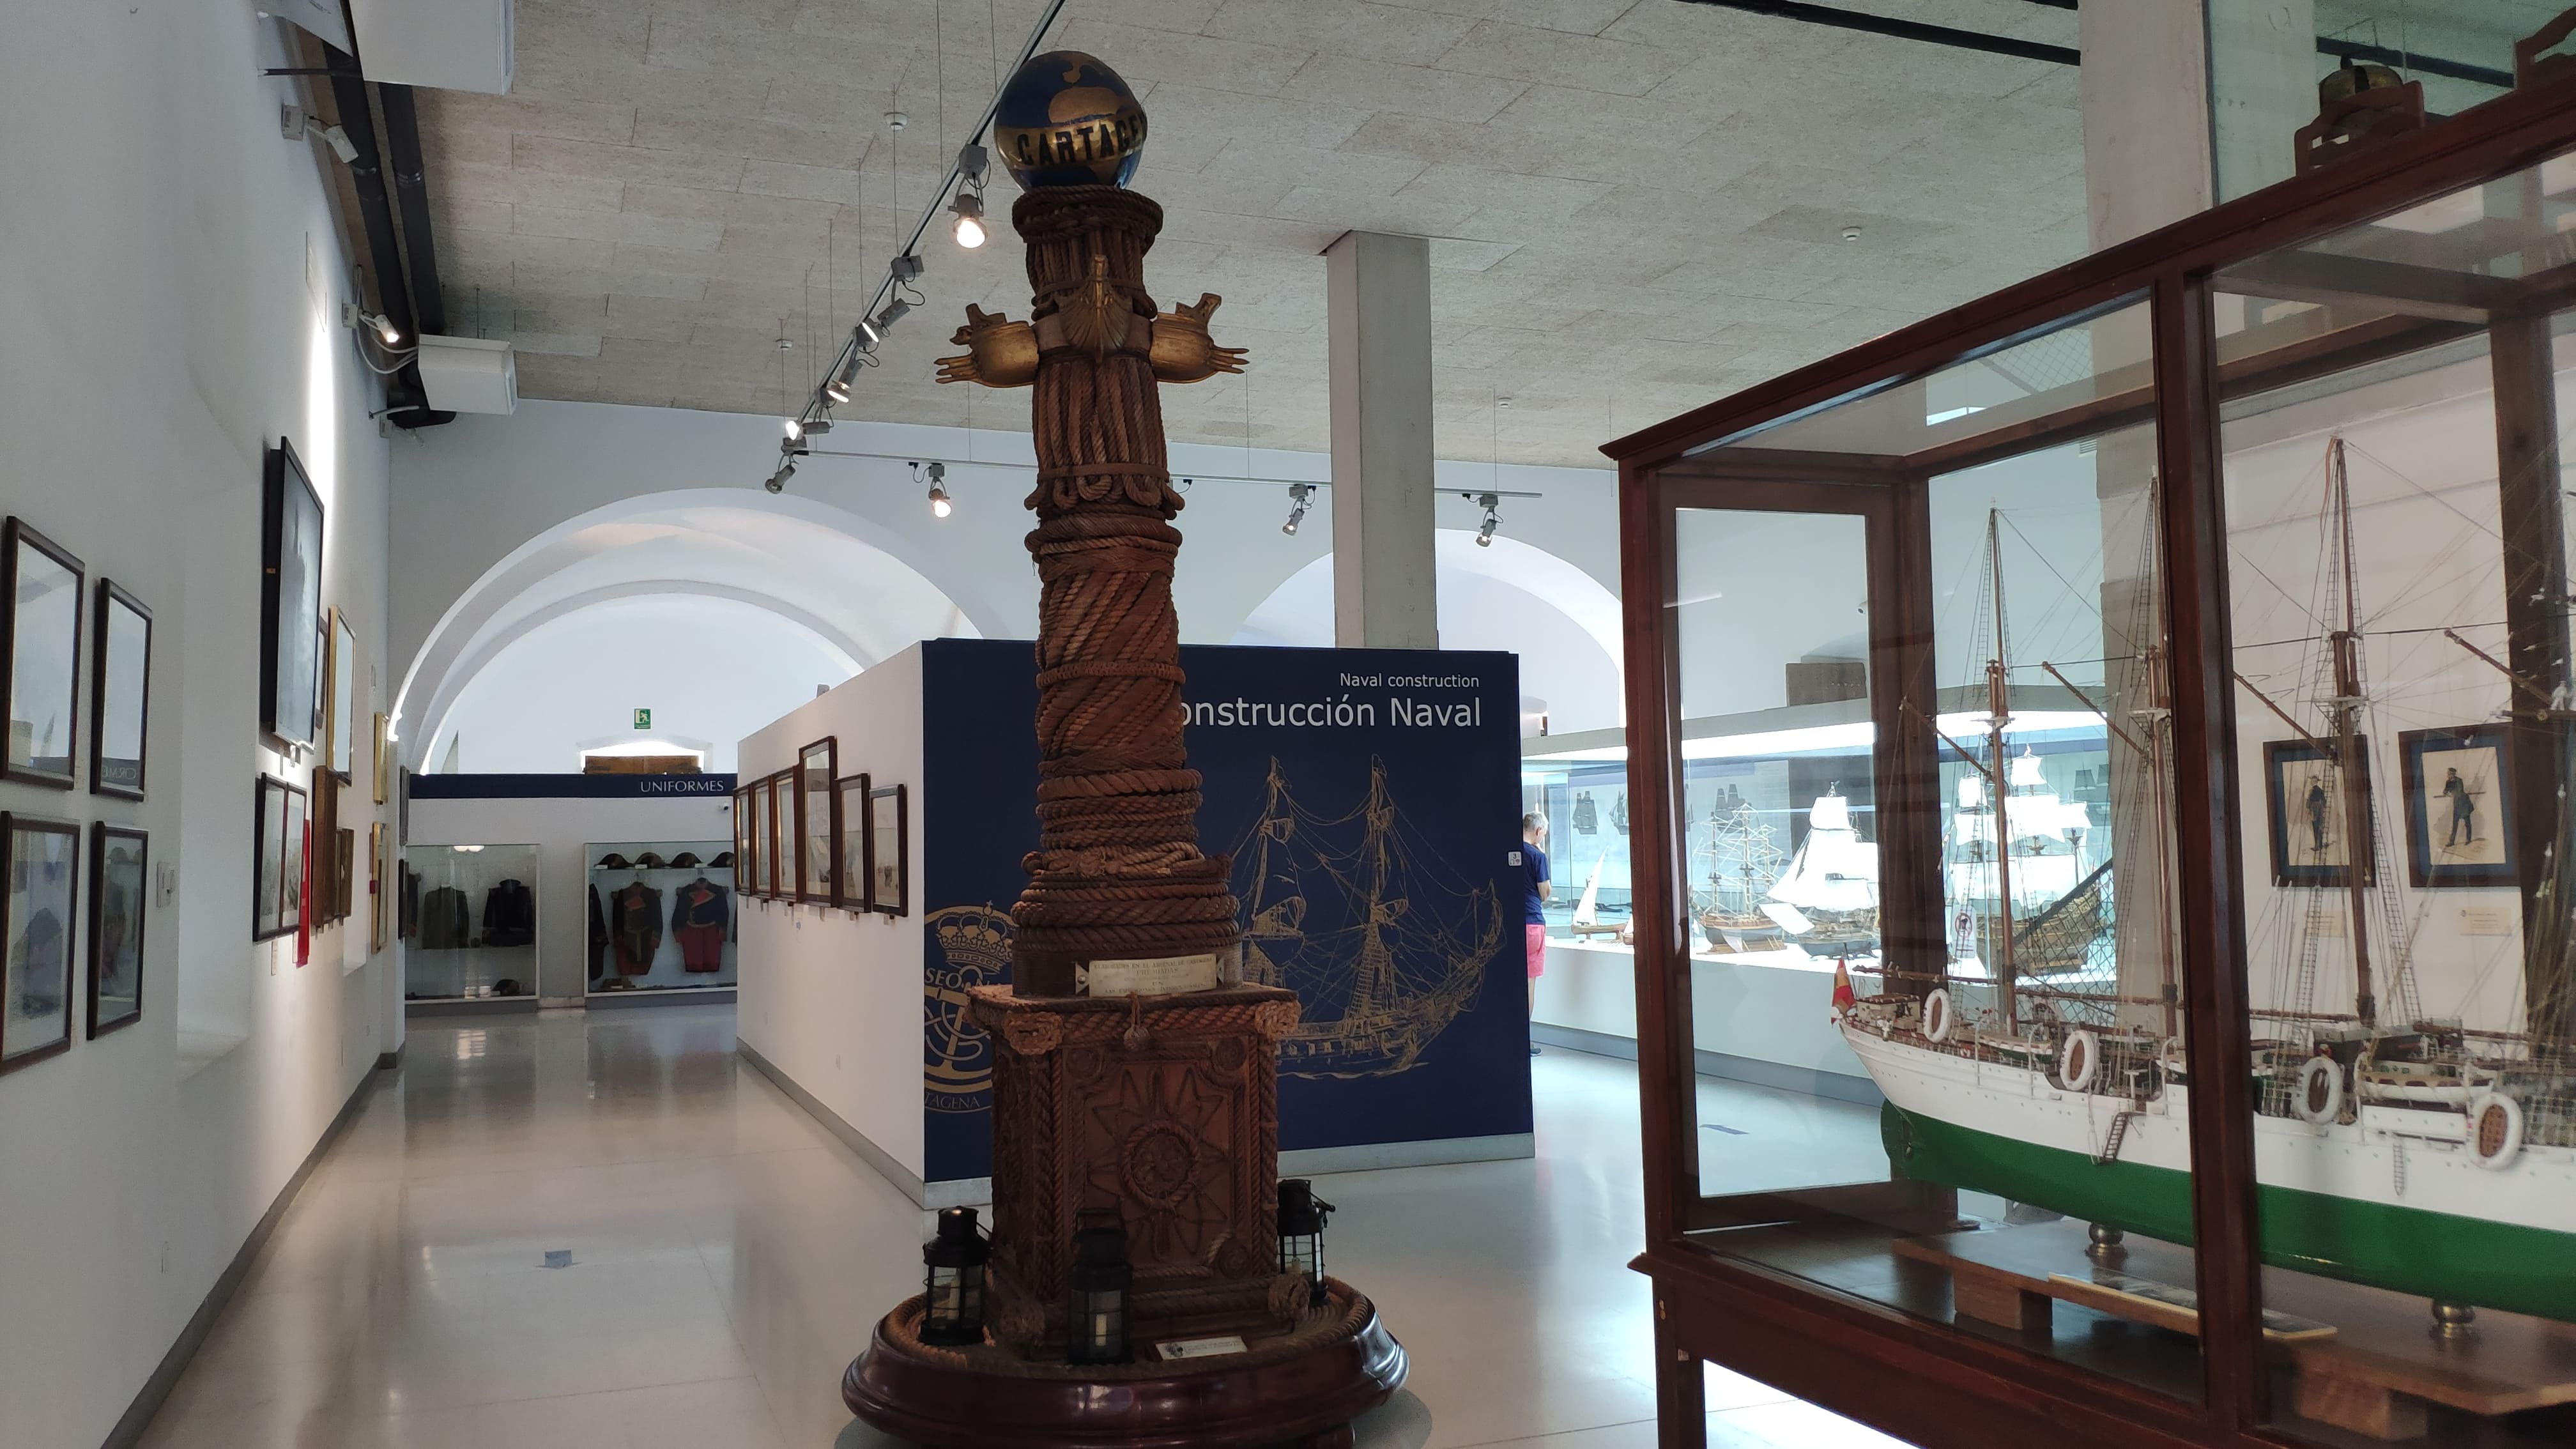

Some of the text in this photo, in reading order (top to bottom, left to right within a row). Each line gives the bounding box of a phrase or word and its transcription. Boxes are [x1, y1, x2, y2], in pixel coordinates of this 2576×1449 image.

[1017, 115, 1146, 165] CARTAGE
[1340, 673, 1480, 687] Naval construction
[1181, 694, 1481, 726] onstrucción Naval
[641, 780, 724, 792] UNIFORMES
[924, 967, 963, 988] SEO
[924, 1091, 981, 1110] TAGENA
